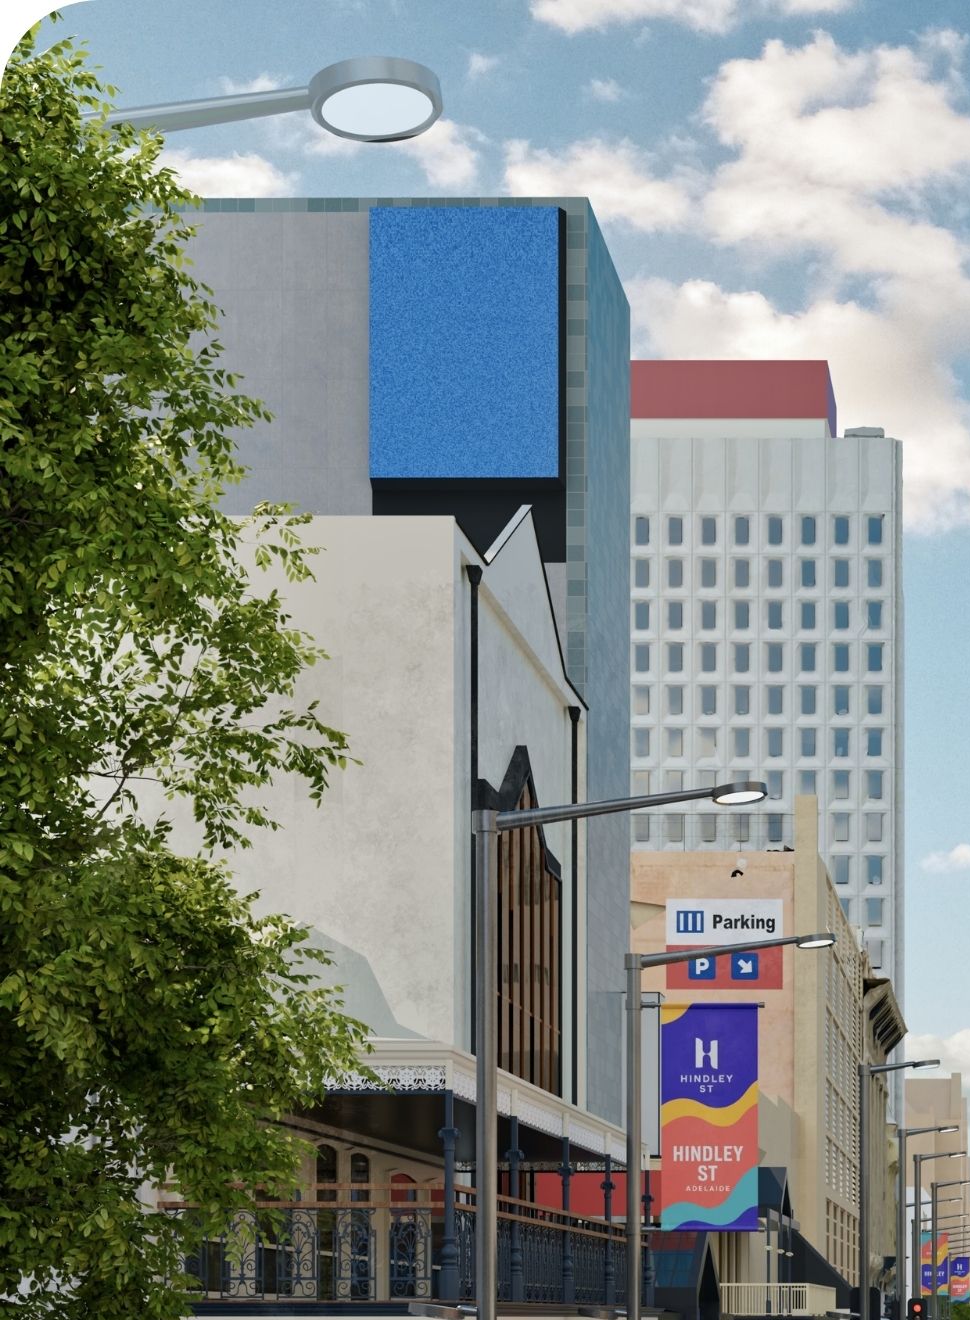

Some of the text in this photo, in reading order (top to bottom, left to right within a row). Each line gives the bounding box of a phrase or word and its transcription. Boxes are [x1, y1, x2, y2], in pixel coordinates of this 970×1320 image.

[712, 914, 776, 934] Parking
[695, 957, 710, 975] P
[680, 1074, 734, 1083] HINDLEY
[699, 1084, 714, 1093] ST
[672, 1145, 744, 1162] HINDLEY
[697, 1164, 718, 1182] ST
